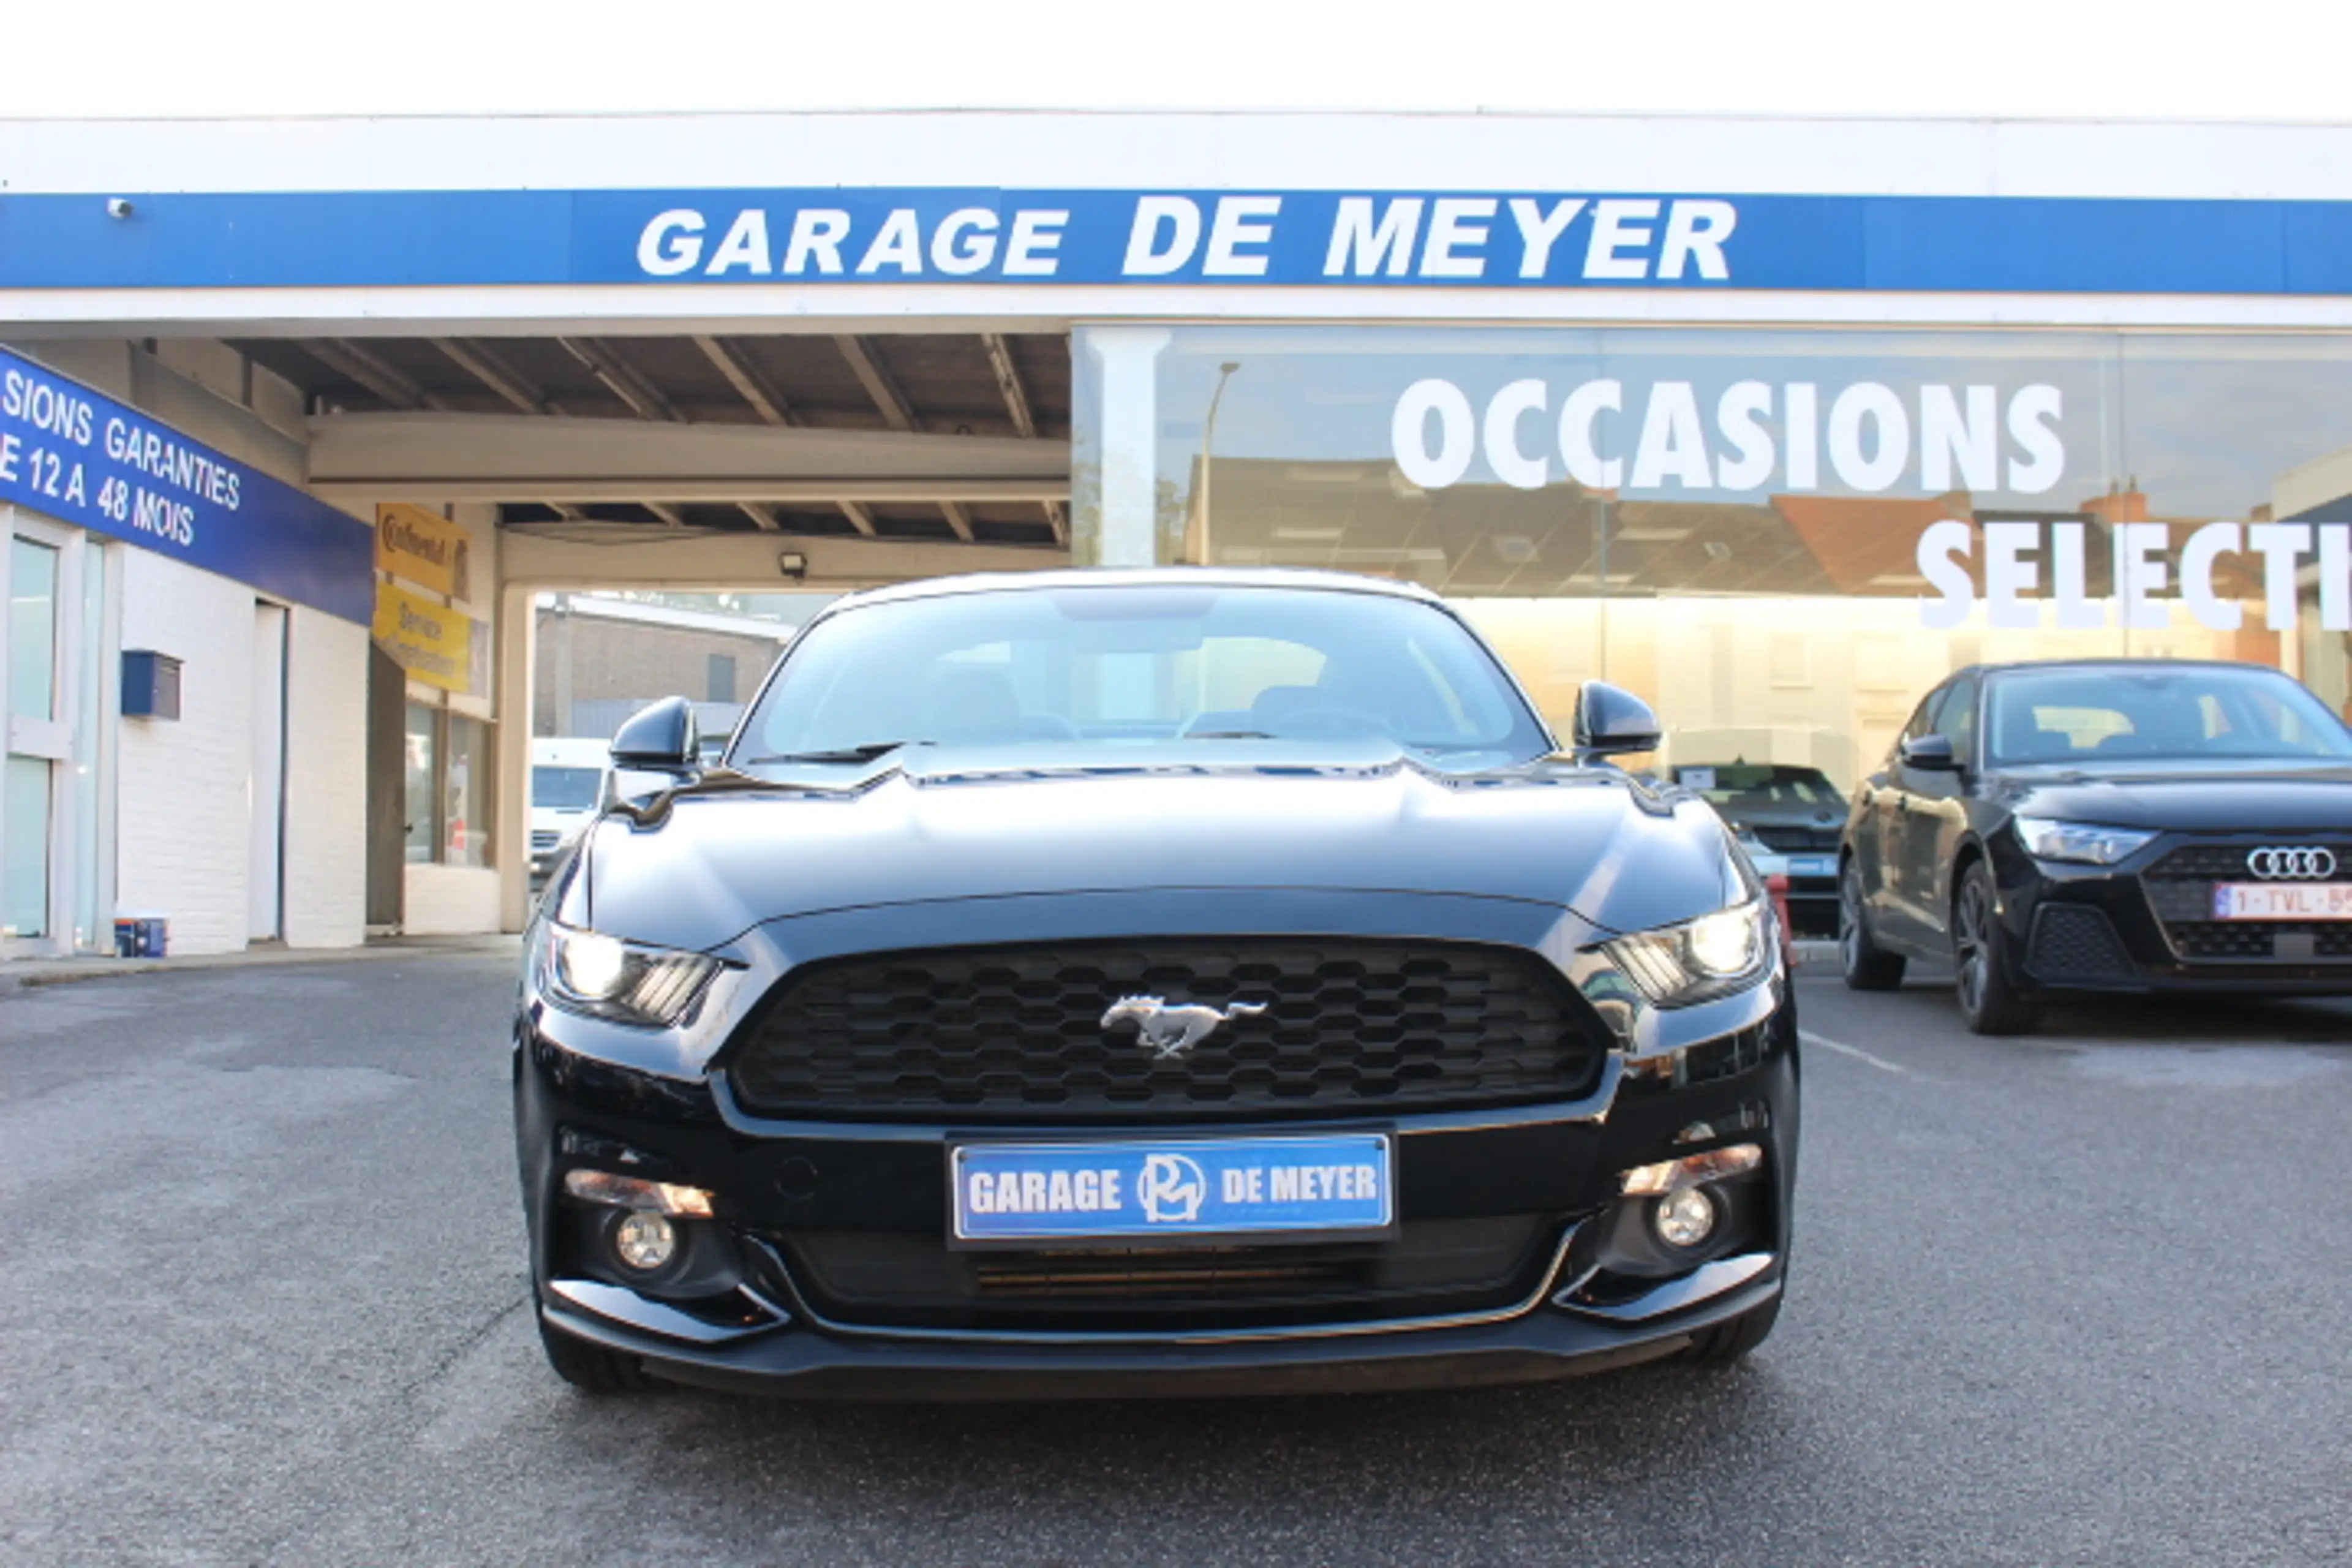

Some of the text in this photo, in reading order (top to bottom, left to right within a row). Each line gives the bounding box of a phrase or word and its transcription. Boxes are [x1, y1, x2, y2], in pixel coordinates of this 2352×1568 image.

[636, 195, 1738, 280] GARAGE DE MEYER
[2, 369, 240, 511] SIONS GARANTIES
[1391, 378, 2066, 494] OCCASIONS
[30, 448, 60, 497] 12
[65, 464, 86, 507] A
[98, 476, 129, 522] 48
[134, 488, 194, 546] MOIS
[1917, 519, 2350, 631] SELECTI
[969, 1169, 1122, 1214] GARAGE
[1222, 1168, 1263, 1204] DE
[1270, 1166, 1377, 1202] MEYER
